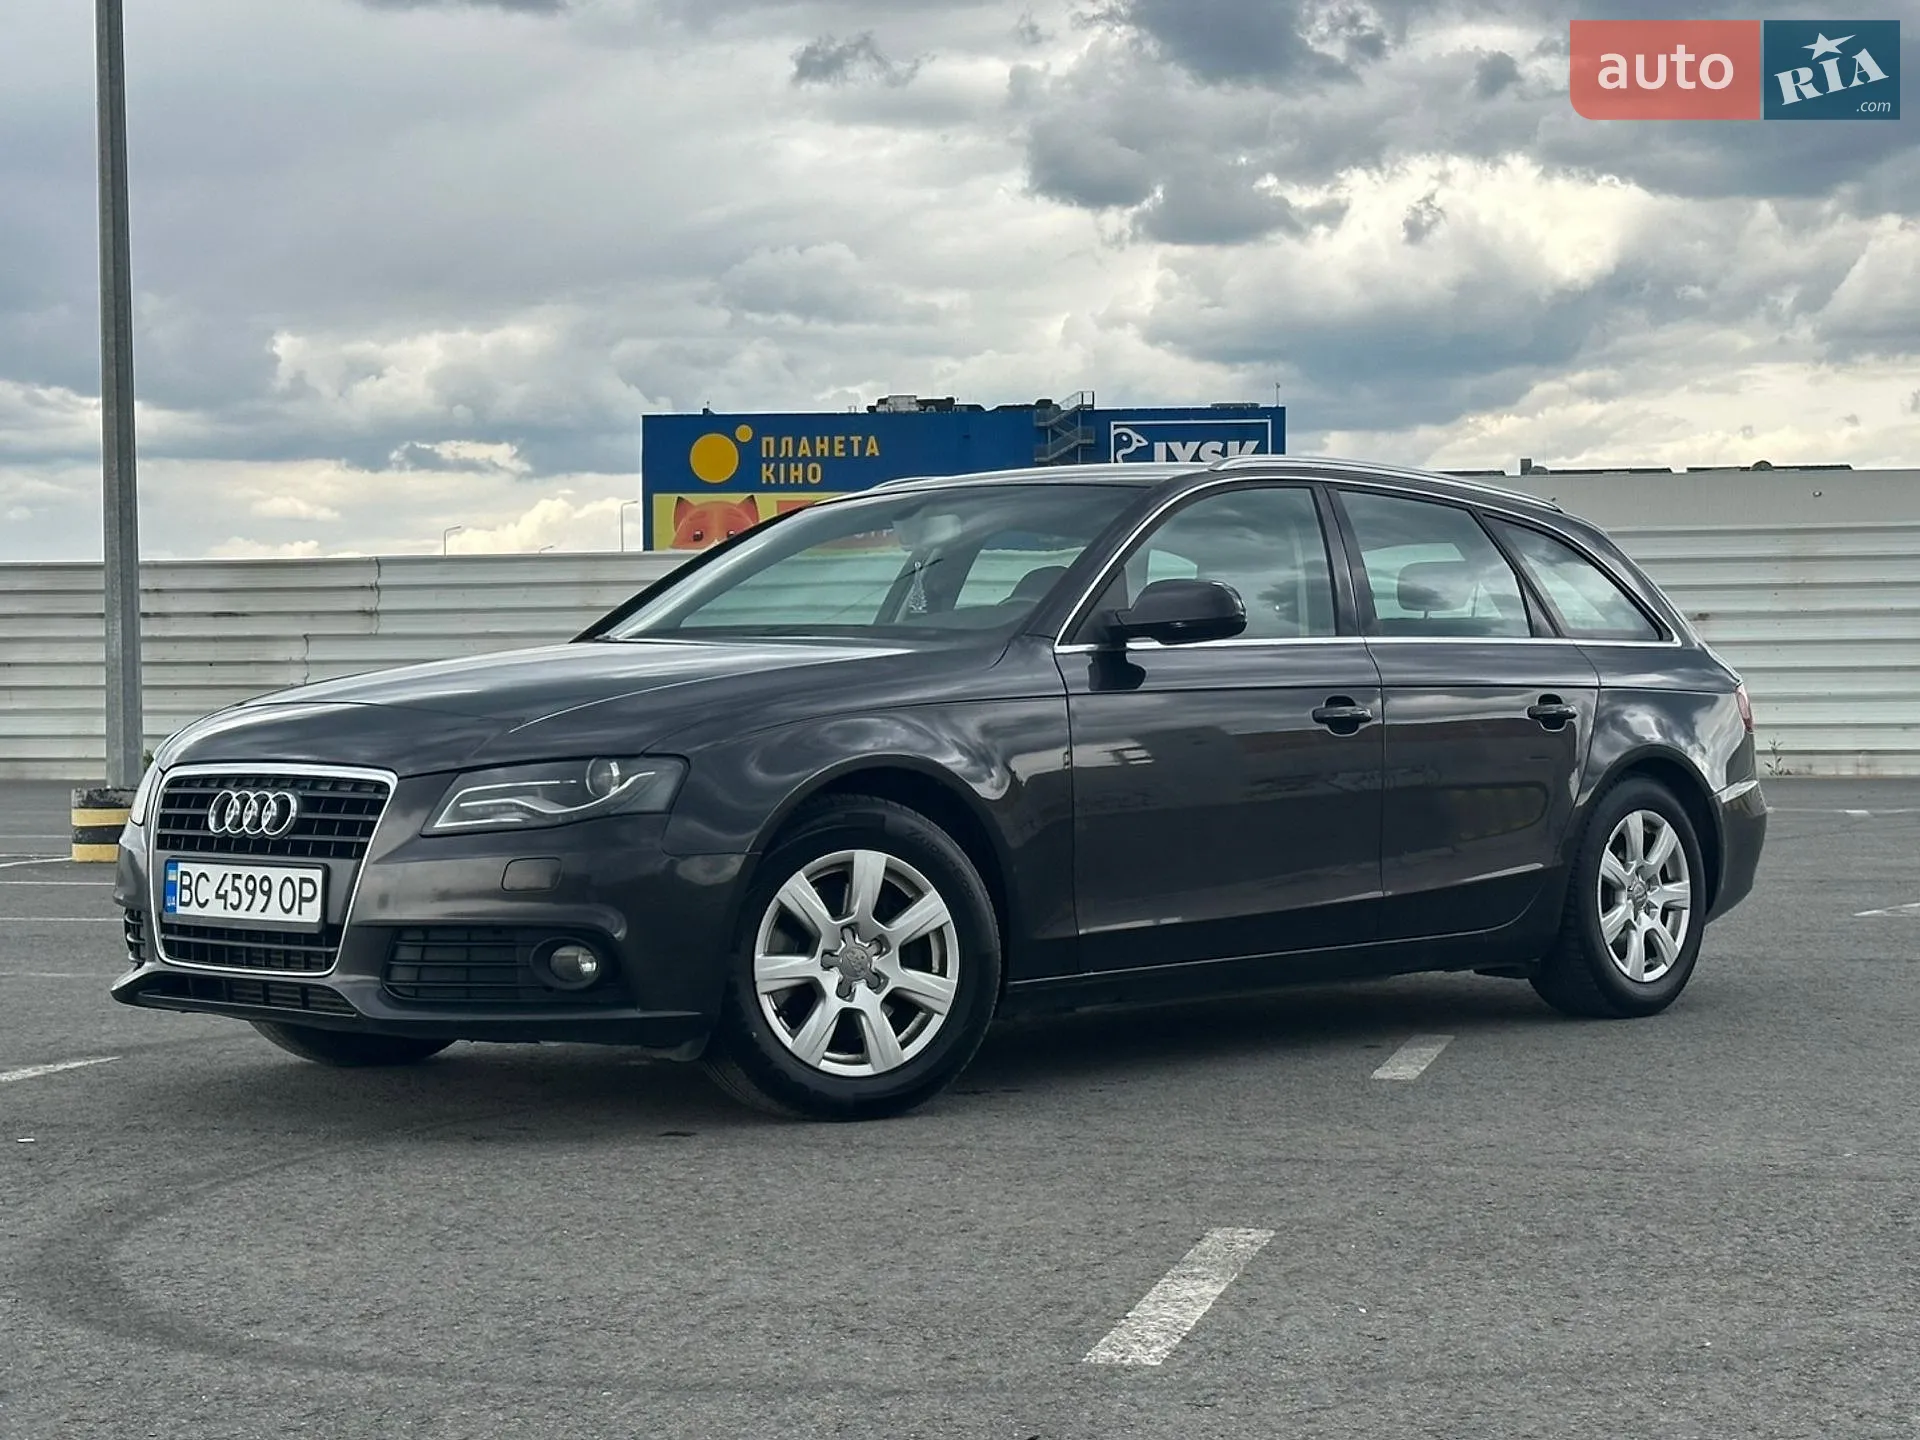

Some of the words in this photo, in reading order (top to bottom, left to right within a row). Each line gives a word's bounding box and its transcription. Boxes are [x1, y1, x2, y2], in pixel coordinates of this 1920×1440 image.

[761, 435, 880, 458] ПЛАНЕТА
[761, 462, 822, 484] КІНО
[179, 870, 210, 908] BC
[215, 872, 273, 913] 4599
[279, 876, 317, 915] OP
